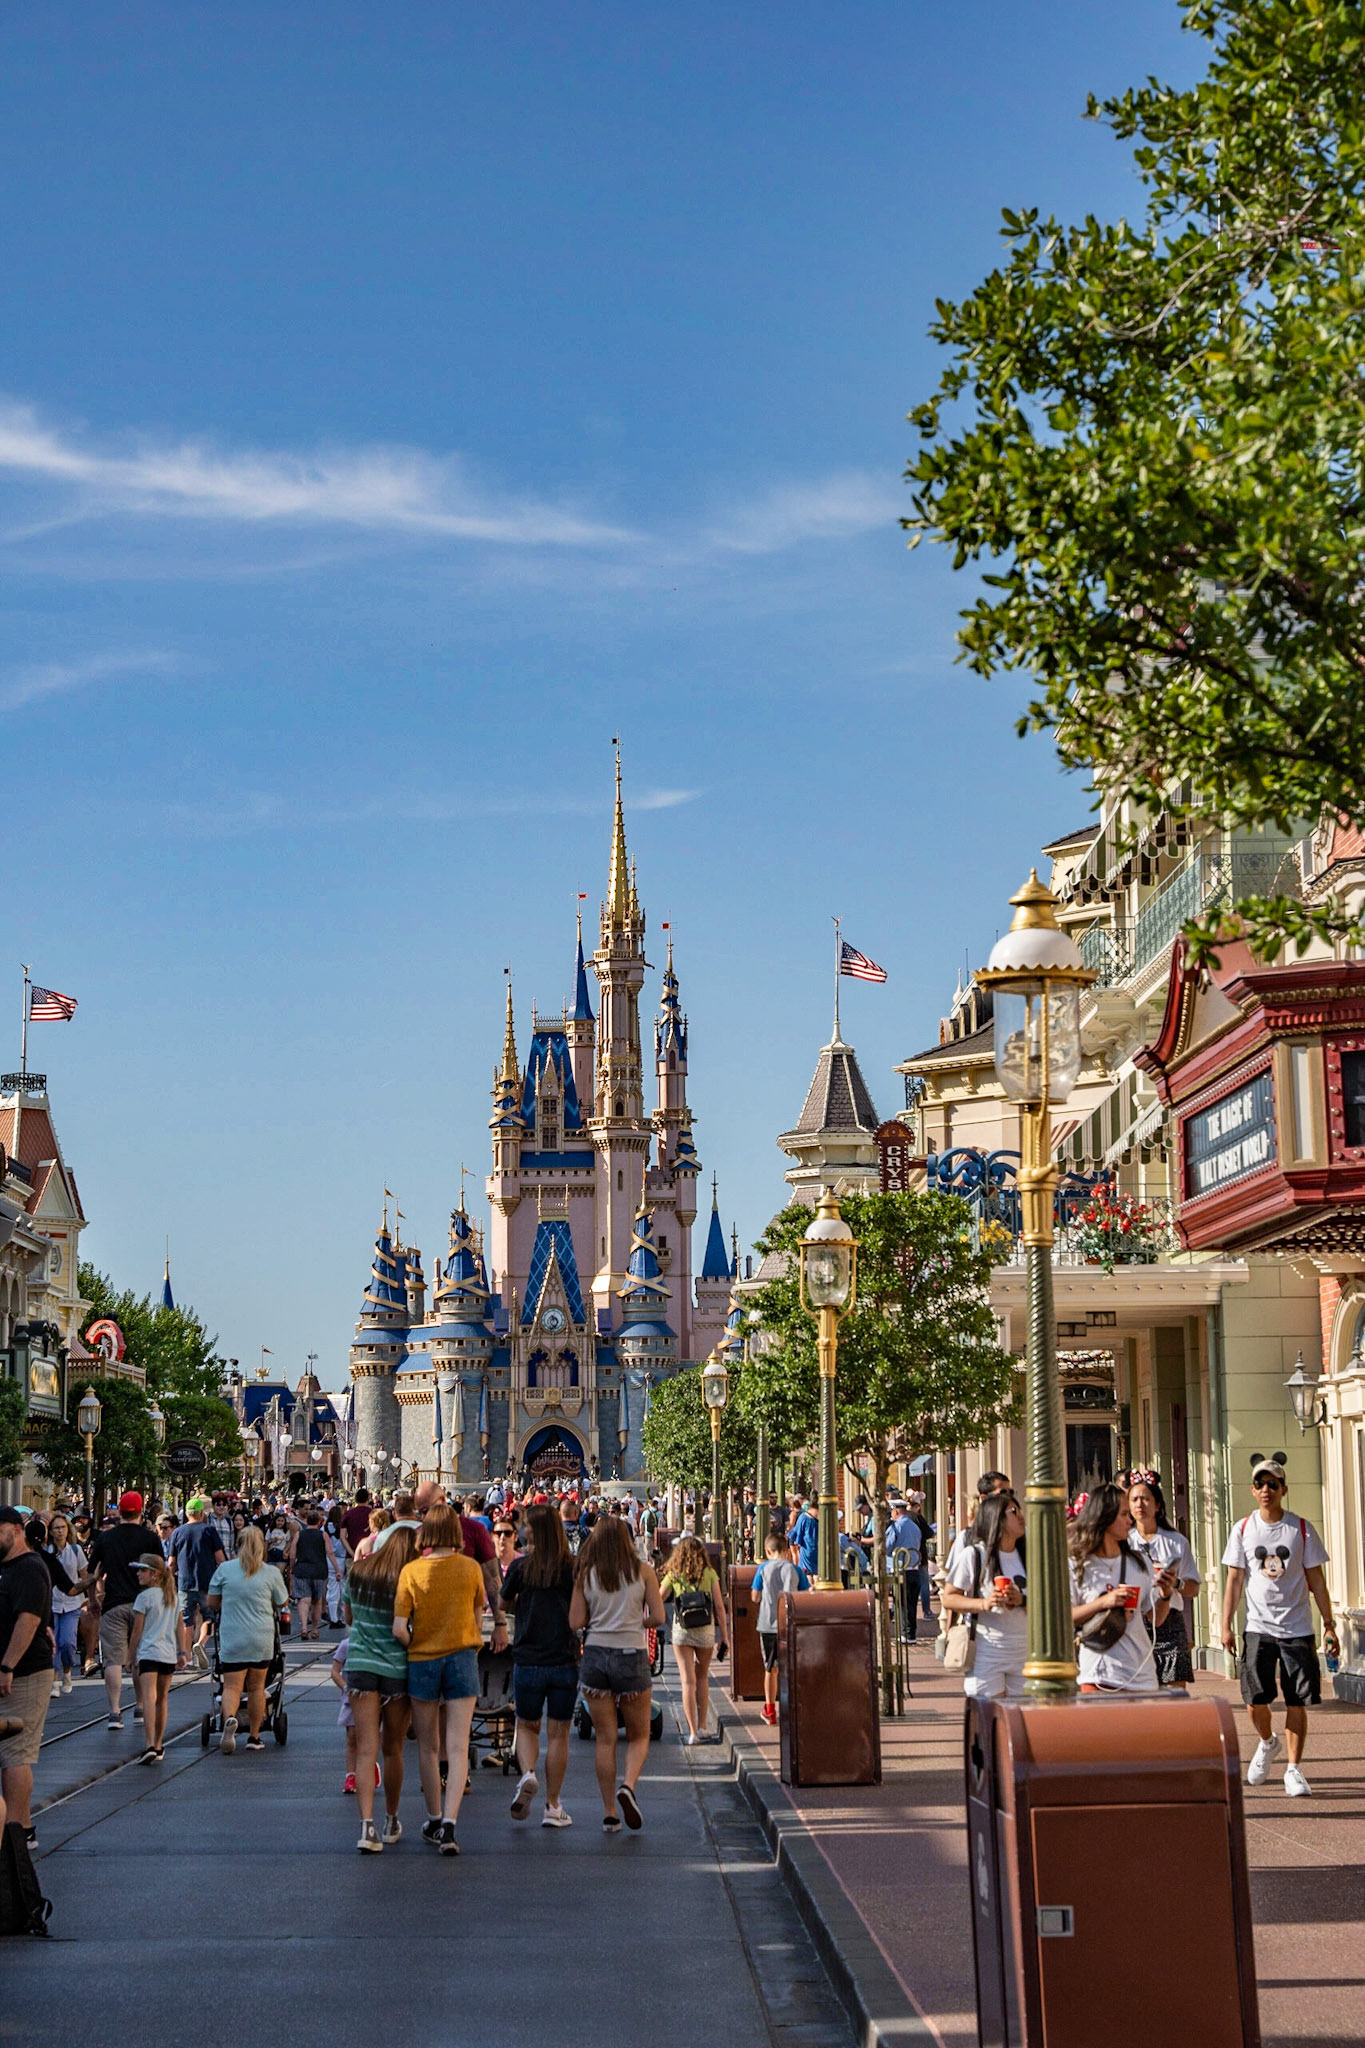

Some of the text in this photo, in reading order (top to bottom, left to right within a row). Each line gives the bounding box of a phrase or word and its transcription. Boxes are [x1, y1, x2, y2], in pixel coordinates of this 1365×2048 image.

[1207, 1091, 1253, 1142] THE MAGIC OF
[887, 1145, 902, 1193] CRYS
[1199, 1130, 1268, 1188] WALT DISNEY WORLD
